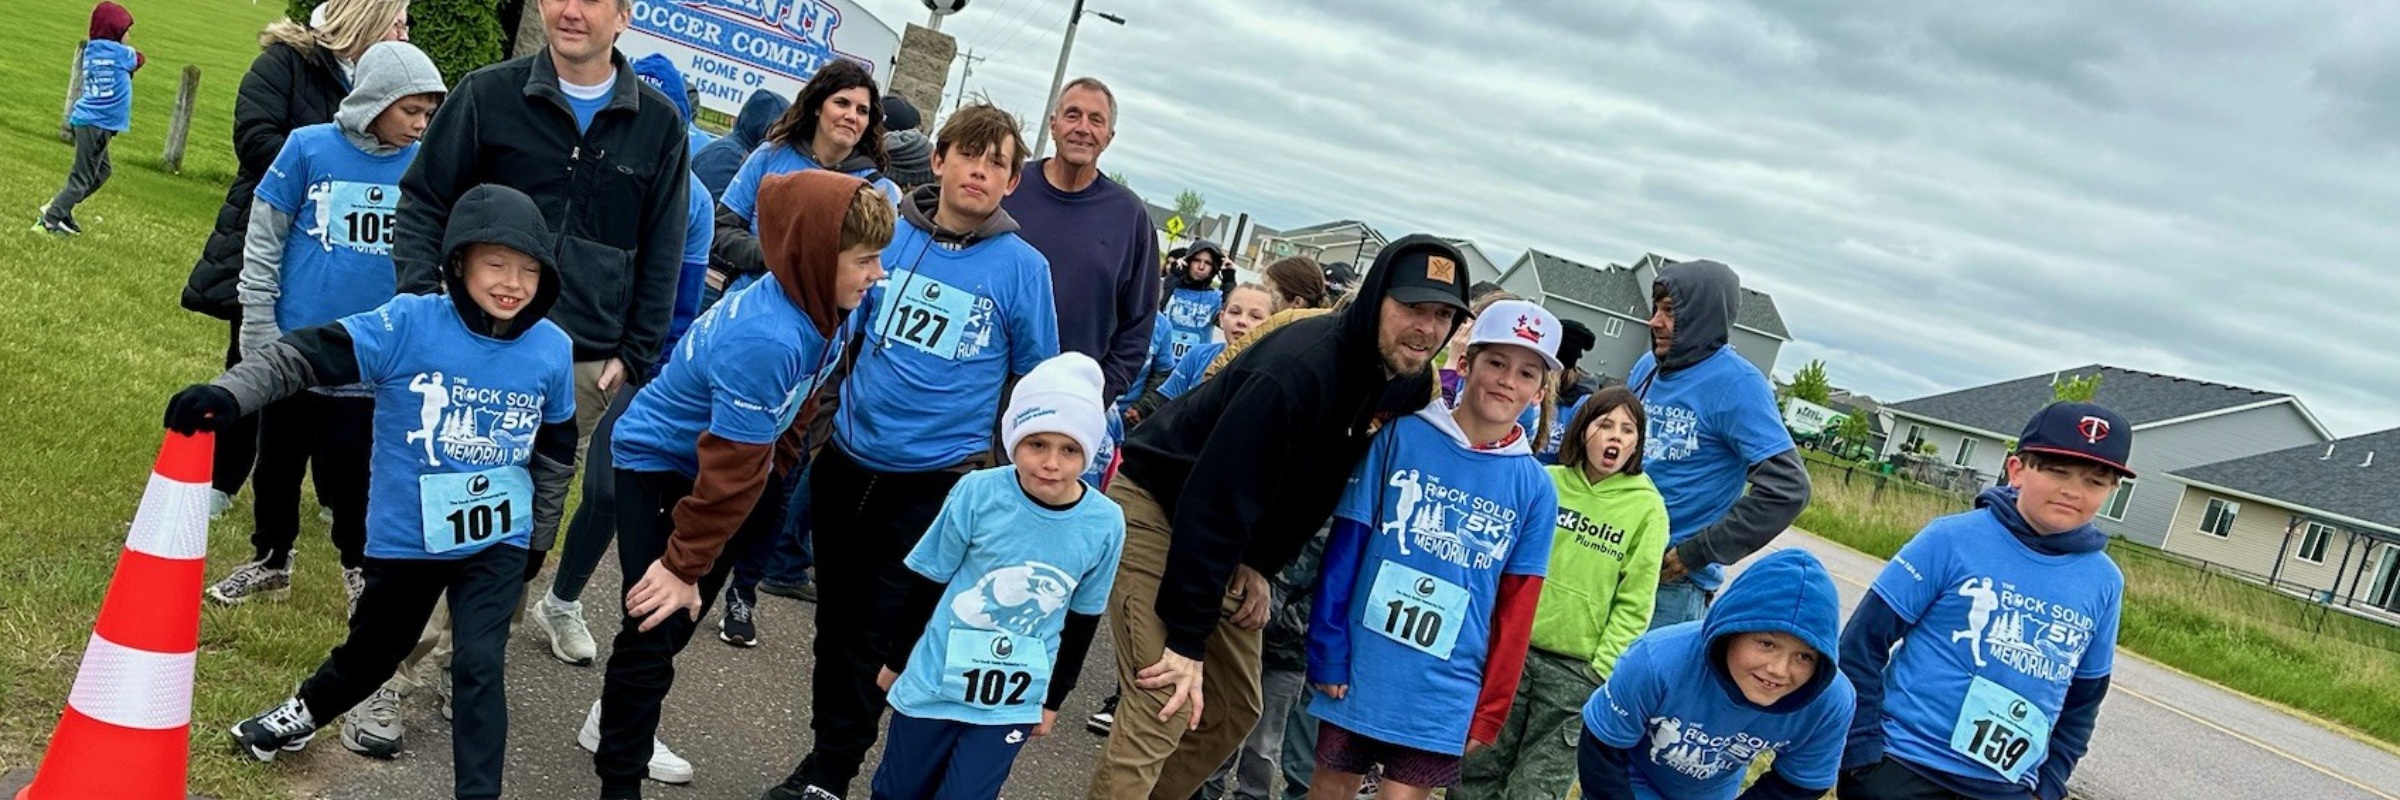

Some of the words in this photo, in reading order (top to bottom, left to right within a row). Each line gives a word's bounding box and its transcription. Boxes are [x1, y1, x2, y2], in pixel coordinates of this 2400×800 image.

[631, 1, 722, 45] OCCER
[731, 31, 831, 75] COMPL
[692, 55, 738, 81] HOME
[743, 71, 765, 88] OF
[344, 211, 395, 245] 105
[895, 304, 949, 349] 127
[452, 385, 502, 406] ROCK
[501, 411, 538, 430] 5K
[443, 443, 508, 466] MEMORIAL
[1668, 447, 1691, 461] RUN
[1424, 482, 1470, 506] ROCK
[1471, 495, 1516, 523] SOLID
[446, 499, 511, 545] 101
[1557, 511, 1578, 529] ck
[1578, 516, 1626, 546] Solid
[1575, 533, 1625, 562] Plumbing
[1384, 599, 1443, 648] 110
[2001, 590, 2048, 615] ROCK
[2051, 604, 2094, 631] SOLID
[1989, 642, 2055, 682] MEMORIAL
[962, 668, 1032, 706] 102
[1968, 719, 2031, 772] 159
